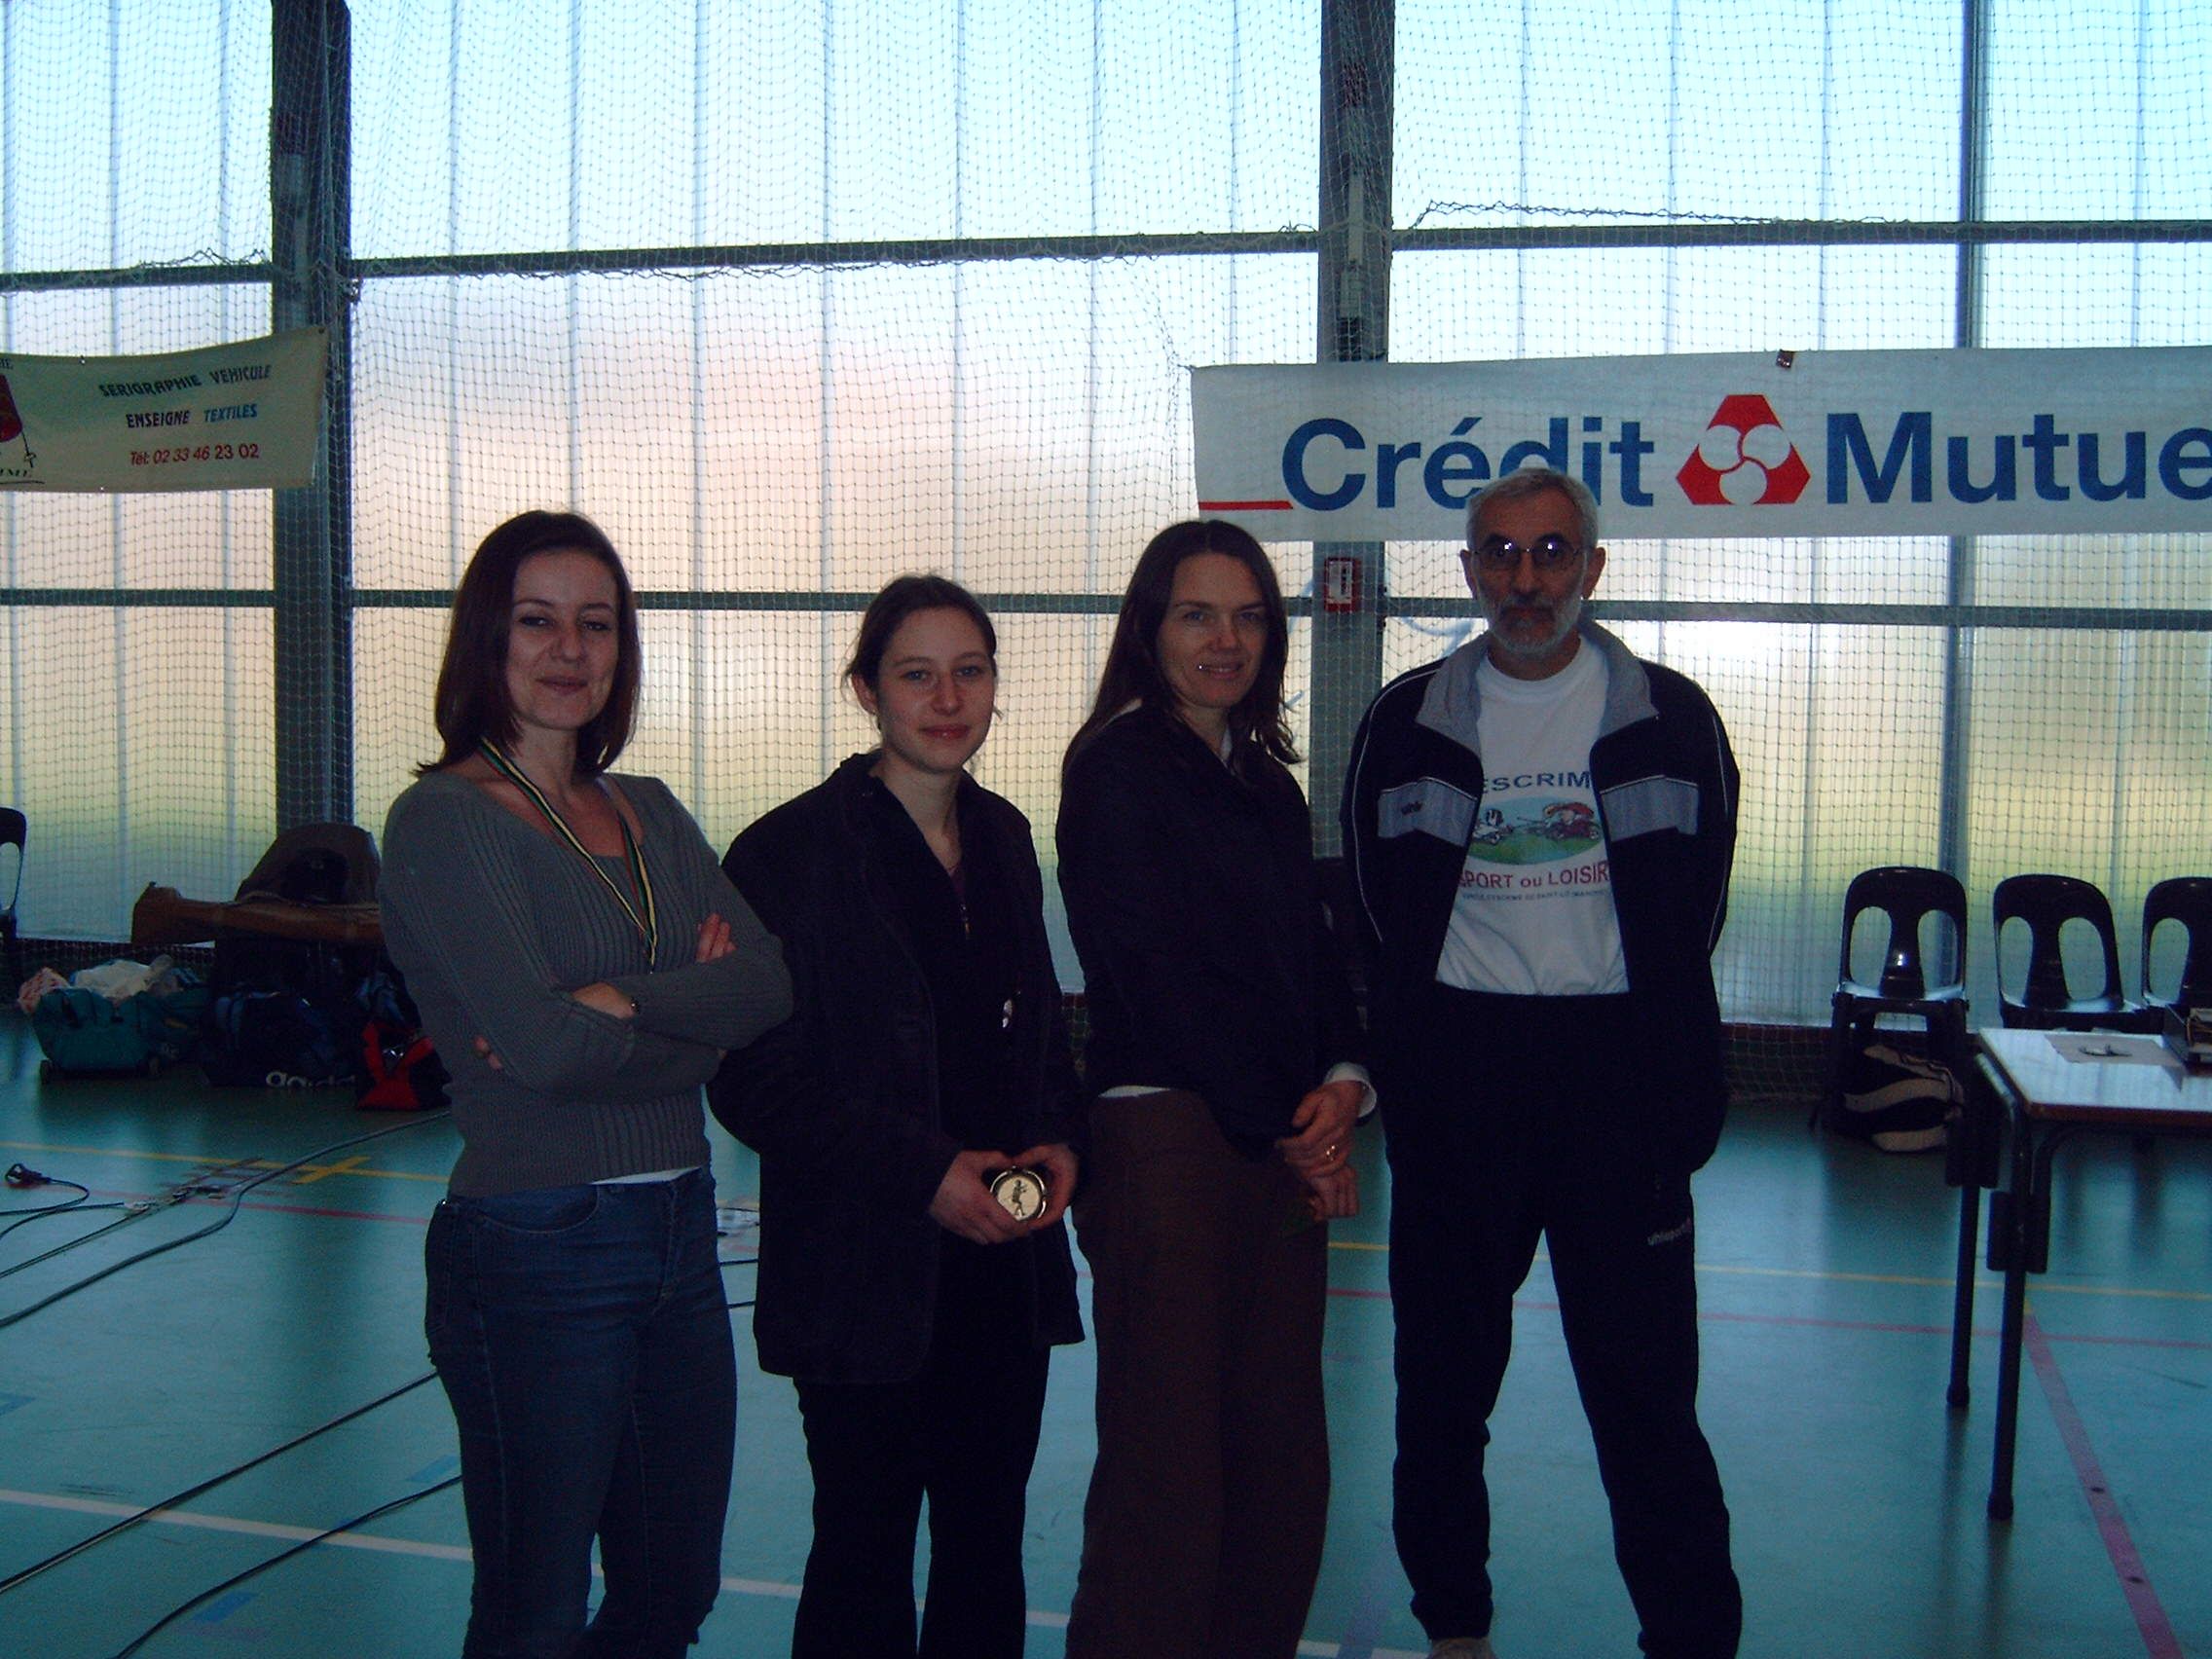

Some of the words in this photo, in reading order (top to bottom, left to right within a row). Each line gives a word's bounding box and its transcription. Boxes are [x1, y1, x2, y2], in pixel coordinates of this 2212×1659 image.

[126, 410, 190, 428] ENSEIGNE
[203, 403, 258, 423] TEXTILES
[153, 449, 170, 464] 02
[172, 447, 190, 461] 33
[193, 445, 210, 461] 46
[214, 444, 234, 460] 23
[238, 443, 260, 459] 02
[1282, 416, 1654, 511] Crédit
[1826, 411, 2212, 504] Mutue
[1521, 877, 1542, 888] ou
